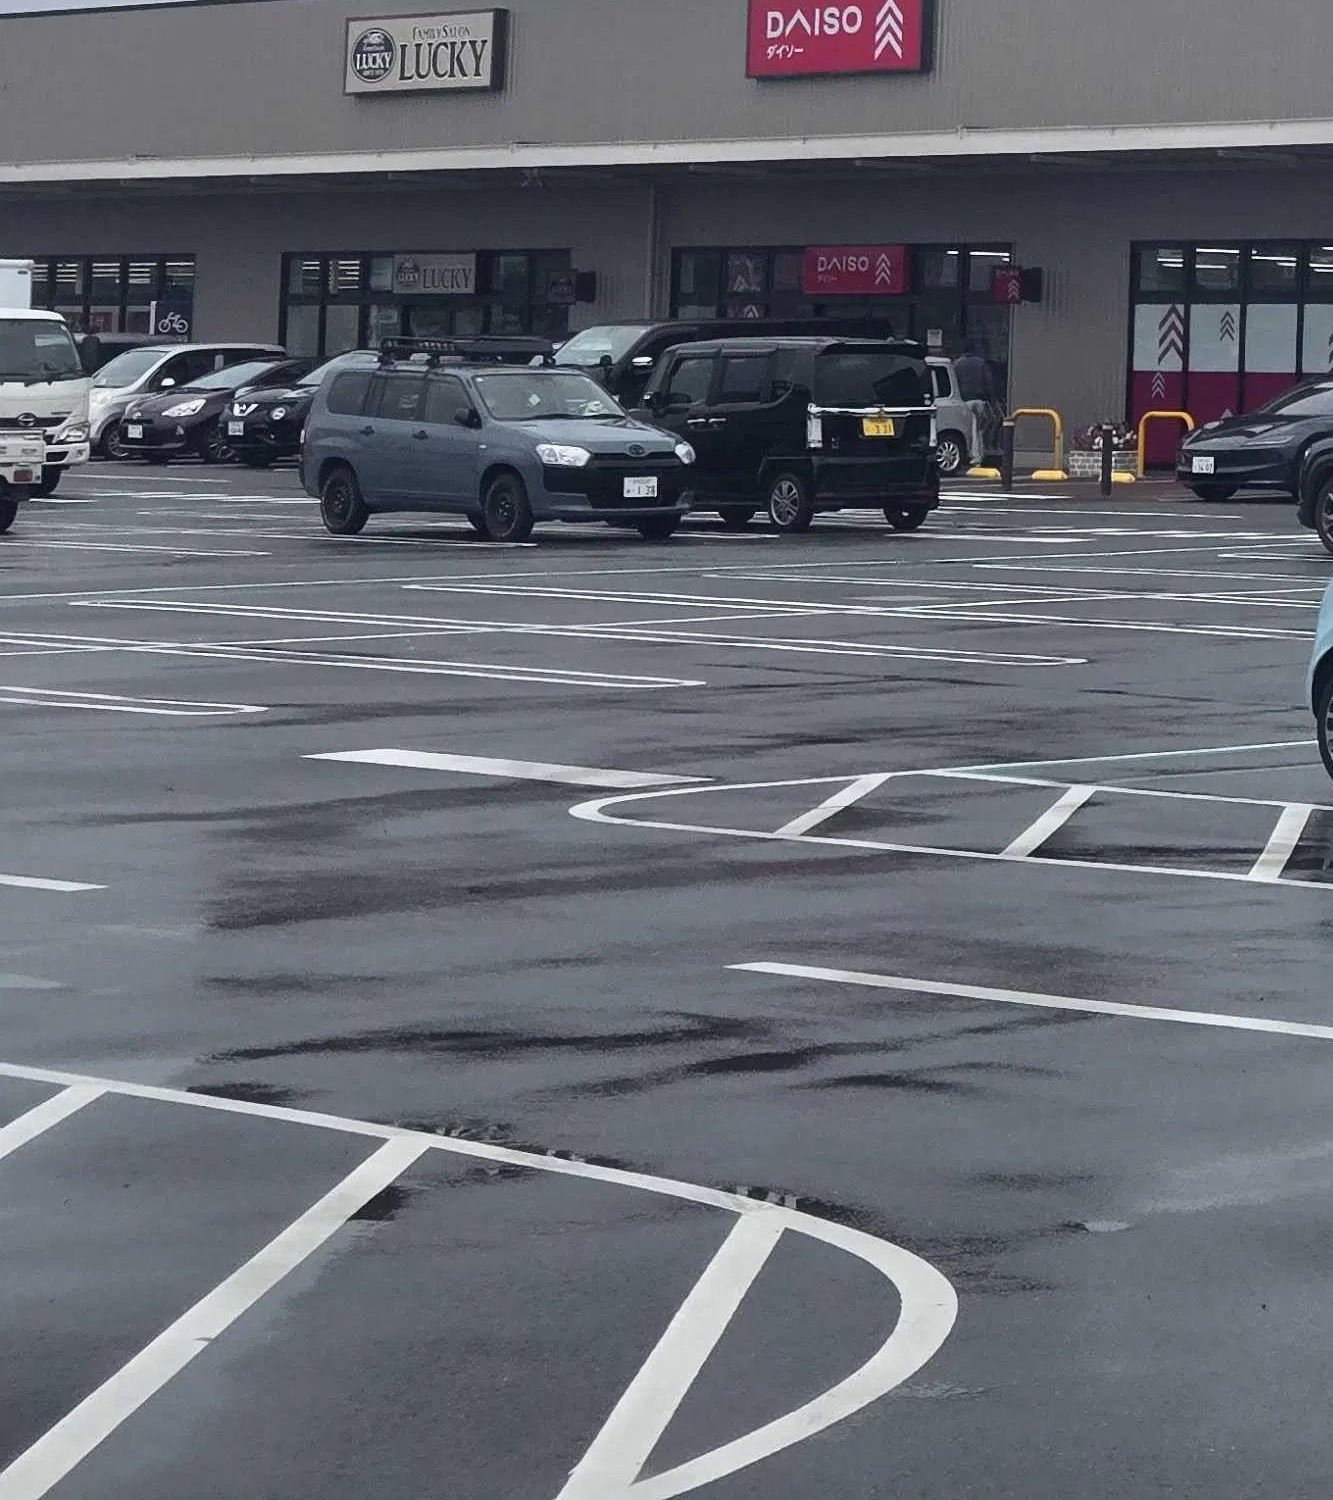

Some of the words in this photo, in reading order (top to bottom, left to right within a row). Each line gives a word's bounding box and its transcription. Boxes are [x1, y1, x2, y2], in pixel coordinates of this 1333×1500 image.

[766, 6, 863, 39] DAISO
[356, 52, 392, 70] LUCKY
[399, 40, 488, 81] LUCKY
[766, 44, 804, 59] ダイソー
[817, 256, 869, 272] DAISO
[423, 268, 472, 289] LUCKY
